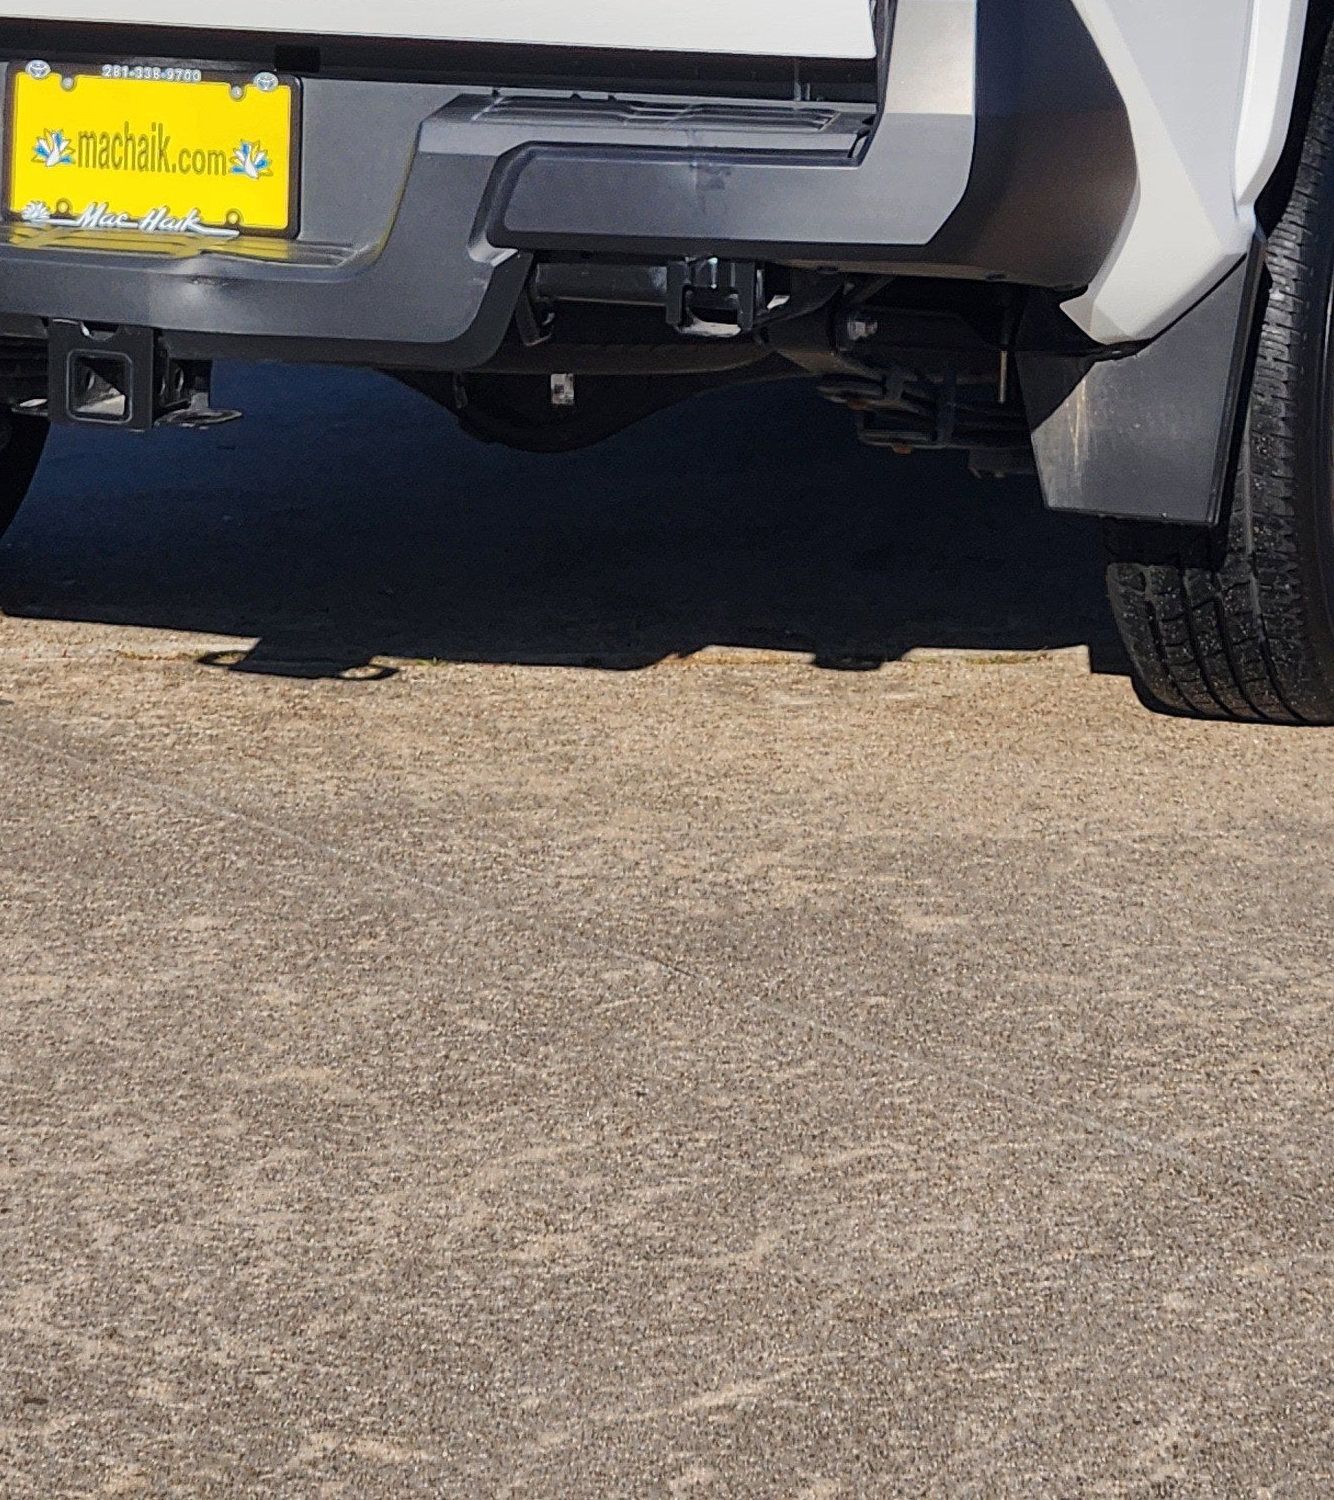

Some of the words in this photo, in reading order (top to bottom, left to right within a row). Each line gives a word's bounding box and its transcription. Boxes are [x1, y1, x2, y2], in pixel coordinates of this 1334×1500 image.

[76, 120, 228, 177] machaik.com
[73, 201, 139, 230] Mac
[138, 205, 217, 236] Haik
